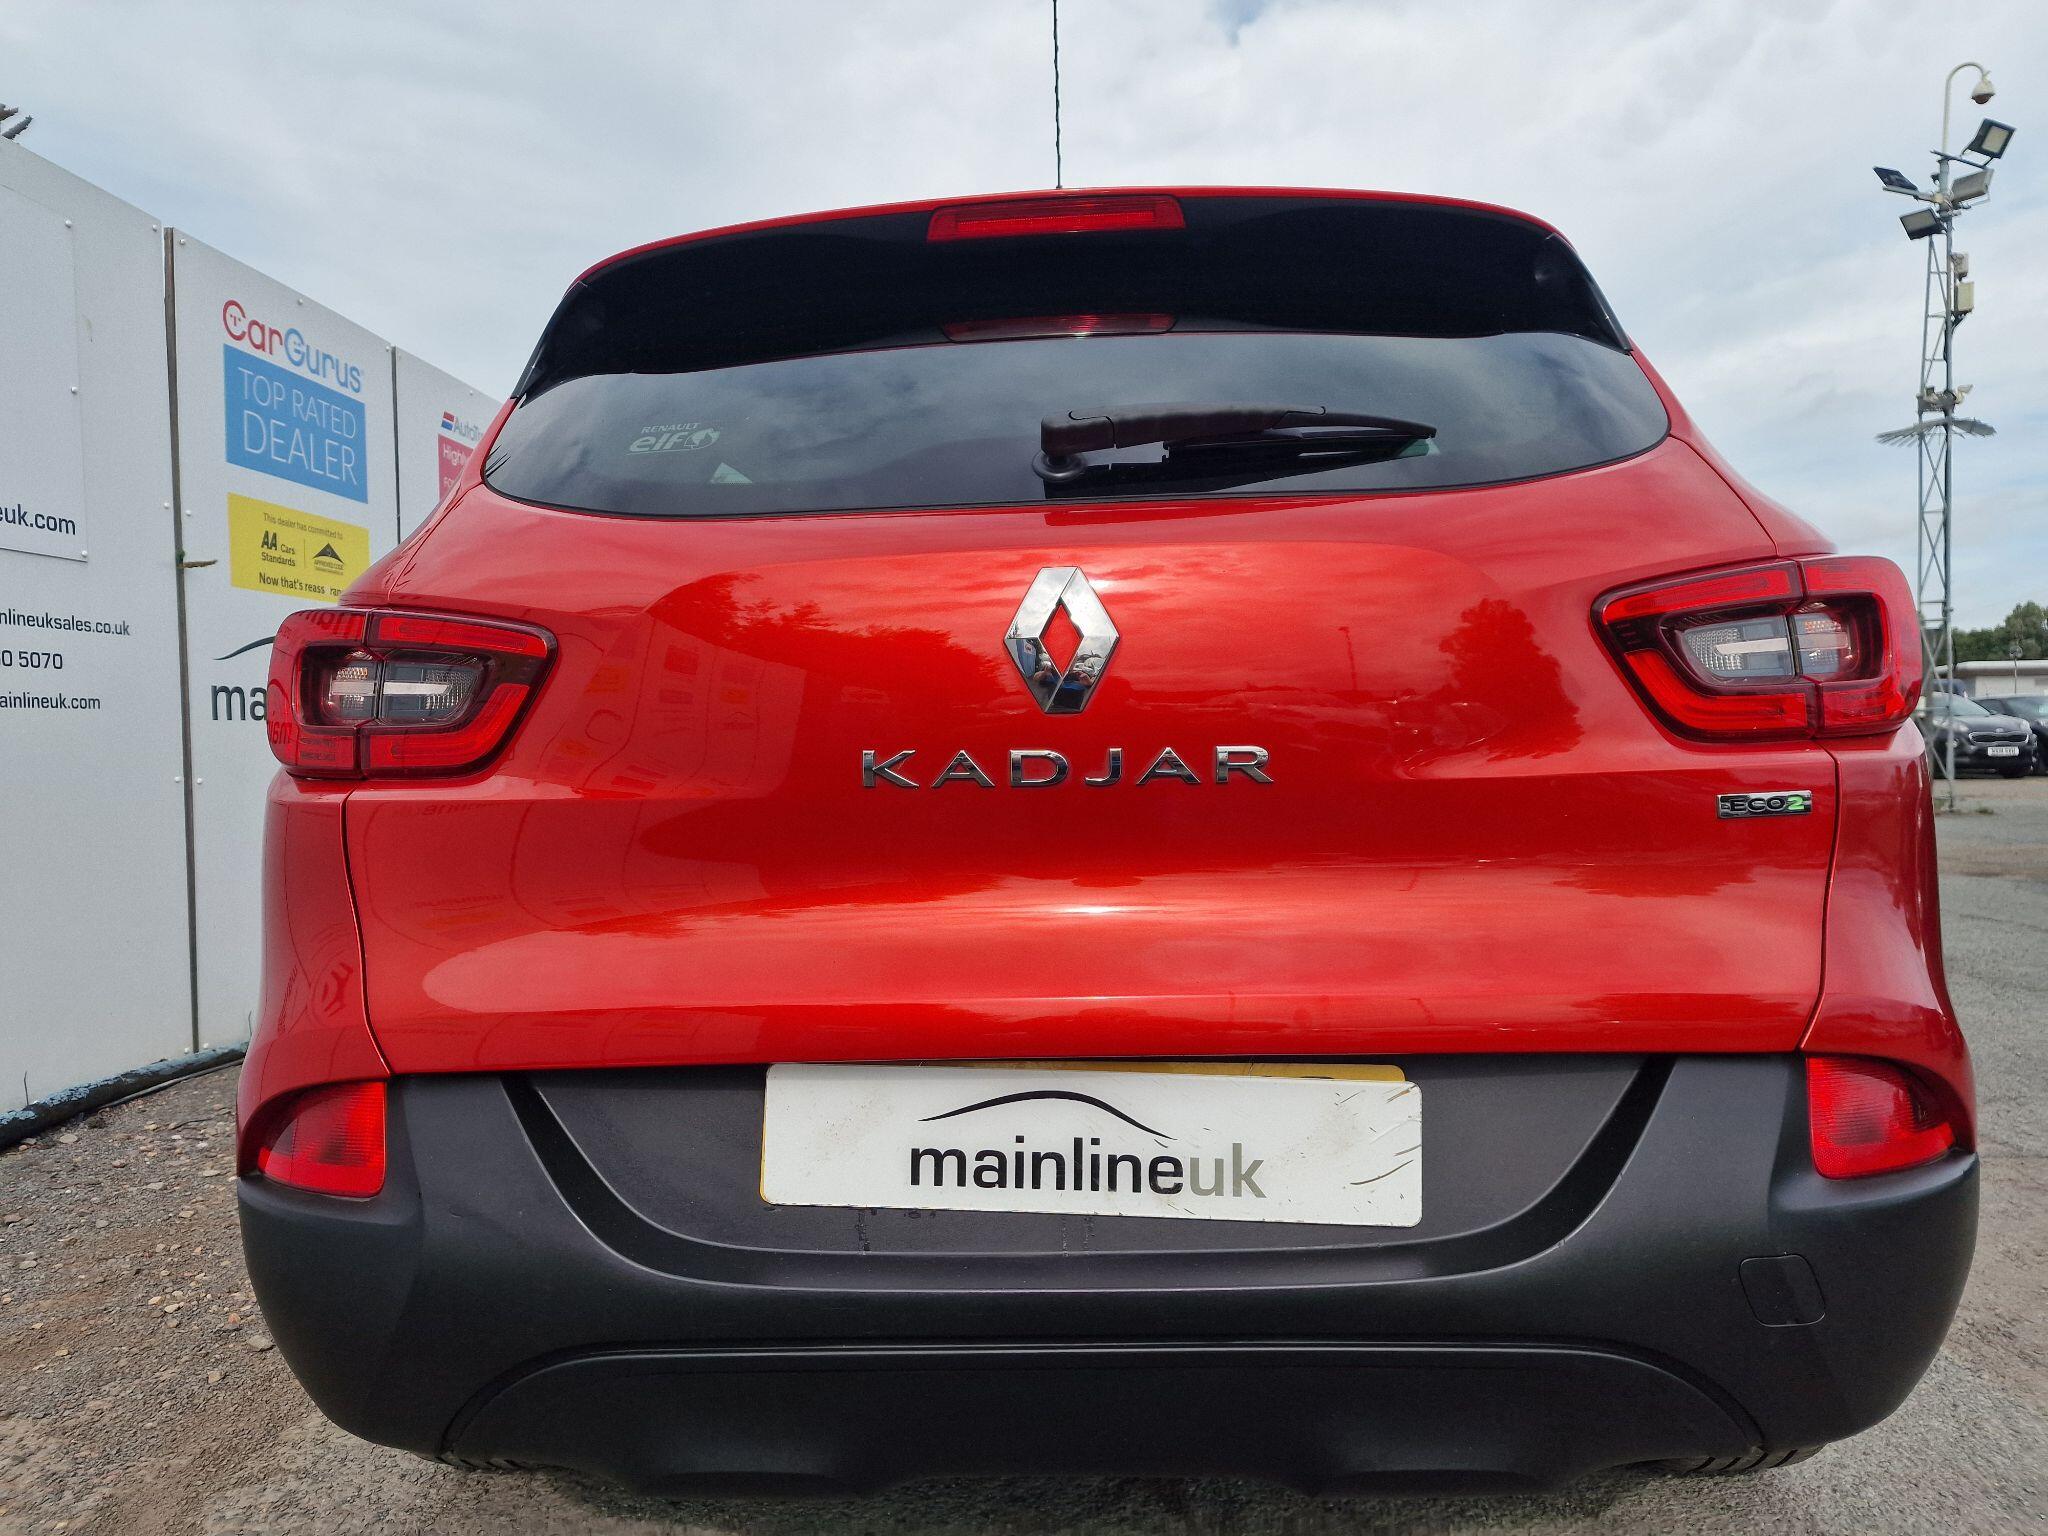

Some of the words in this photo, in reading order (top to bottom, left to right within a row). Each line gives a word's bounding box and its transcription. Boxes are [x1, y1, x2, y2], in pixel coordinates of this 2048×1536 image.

[222, 299, 362, 393] CarGurus
[238, 366, 286, 411] TOP
[293, 389, 356, 440] RATED
[641, 422, 701, 434] RENAULT
[242, 409, 358, 485] DEALER
[629, 431, 689, 452] elf
[263, 512, 277, 525] This
[277, 516, 296, 528] dealer
[296, 521, 307, 531] has
[308, 524, 336, 538] committed
[260, 530, 278, 551] AA
[280, 544, 295, 555] Cars
[261, 551, 296, 567] Standards
[259, 571, 279, 587] Now
[280, 575, 304, 591] that's
[18, 651, 63, 670] 5070
[862, 745, 1274, 788] KADJAR
[1729, 794, 1805, 812] ECO2
[910, 1135, 1267, 1200] mainlineuk
